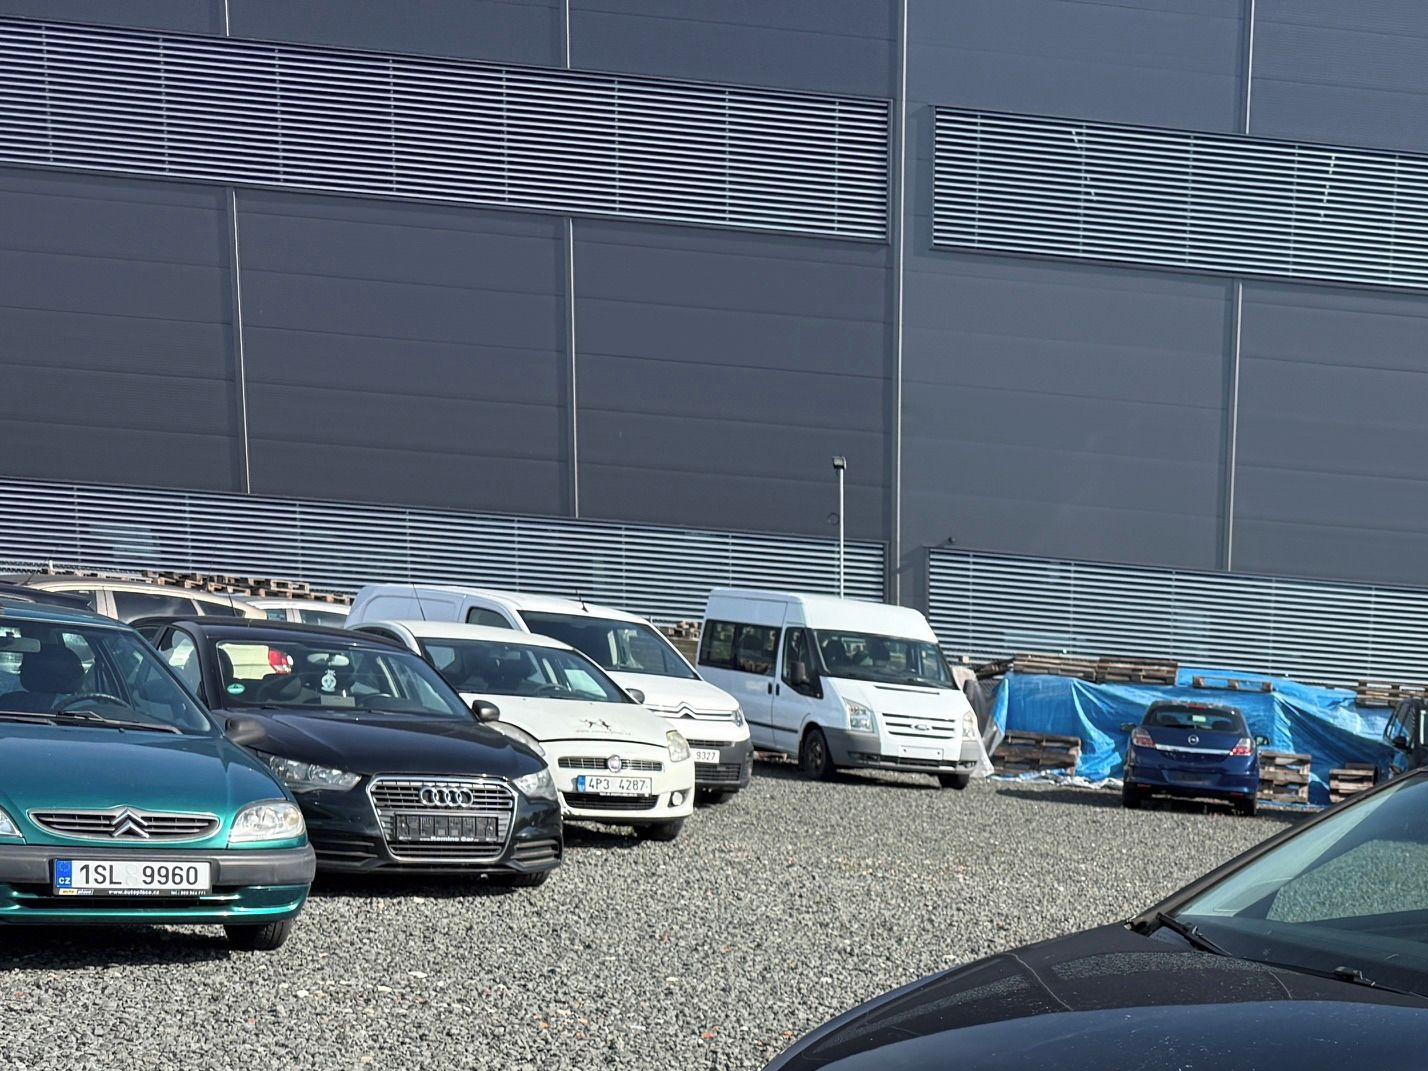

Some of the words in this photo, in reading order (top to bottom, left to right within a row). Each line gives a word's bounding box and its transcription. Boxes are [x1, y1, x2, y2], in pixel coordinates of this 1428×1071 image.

[588, 777, 610, 790] 4P3
[618, 779, 646, 791] 4287
[79, 864, 122, 885] 1SL
[142, 865, 198, 885] 9960
